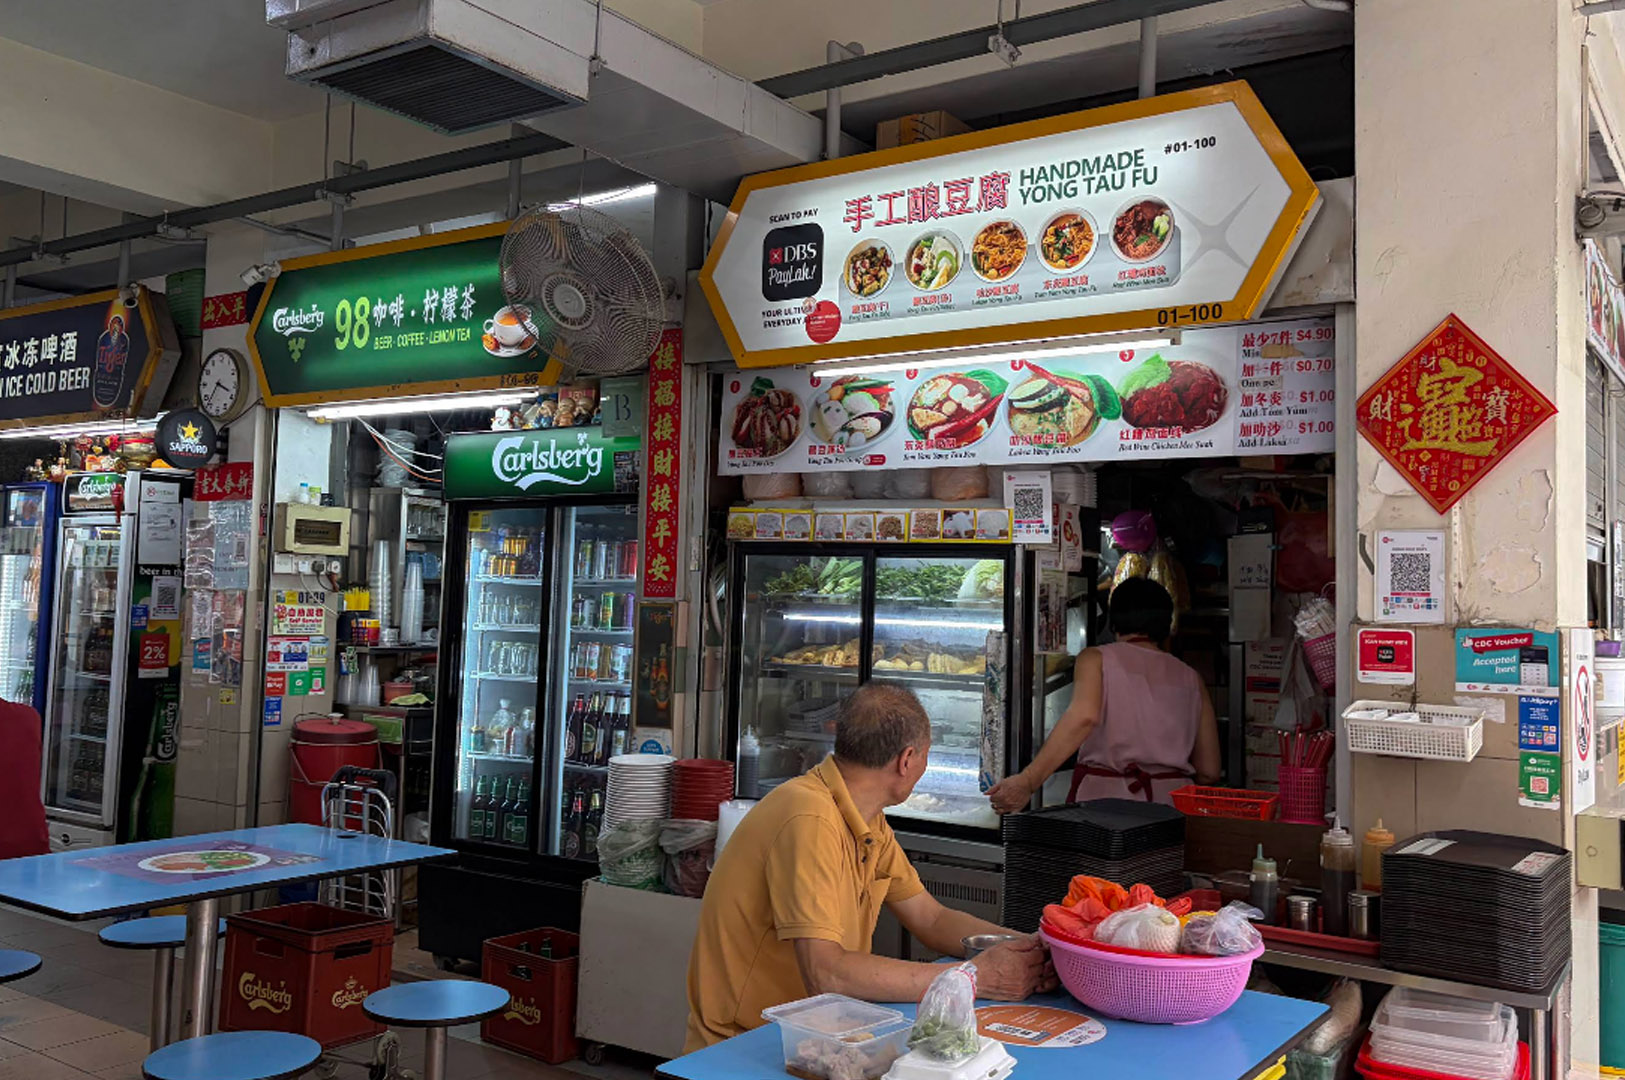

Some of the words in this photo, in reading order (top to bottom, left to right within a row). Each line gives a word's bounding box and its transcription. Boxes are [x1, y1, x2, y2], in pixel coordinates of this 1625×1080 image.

[1163, 136, 1216, 155] #01-100
[1019, 149, 1146, 186] HANDMADE
[1018, 182, 1079, 205] YONG
[1084, 174, 1126, 195] TAU
[1131, 166, 1159, 188] FU
[843, 171, 1011, 233] 手工酿豆腐
[769, 213, 790, 224] SCAN
[791, 211, 802, 220] TO
[803, 208, 819, 218] PAY
[784, 242, 817, 263] DBS
[768, 263, 817, 288] PayLah!
[273, 304, 325, 336] Carlsberg
[335, 296, 370, 350] 98
[762, 308, 782, 318] YOUR
[763, 316, 801, 328] EVERYDAY
[1157, 303, 1223, 325] 01-100
[373, 336, 393, 349] BEER
[397, 333, 424, 347] COFFEE
[429, 330, 455, 345] LEMON
[456, 328, 471, 342] TEA
[5, 375, 23, 398] ICE
[25, 371, 56, 395] COLD
[59, 366, 91, 391] BEER
[1300, 390, 1335, 403] $1.00
[1369, 390, 1394, 422] 財
[1239, 408, 1258, 418] Add
[1286, 406, 1307, 415] Yum
[1239, 421, 1281, 437] 加叻沙
[1298, 421, 1334, 434] $1.00
[169, 441, 208, 455] SAPPORO
[1238, 439, 1256, 447] Add
[492, 433, 603, 490] Carlsberg
[139, 566, 160, 576] beer
[162, 567, 171, 576] in
[143, 645, 166, 660] 2%
[1473, 639, 1493, 648] CDC
[1495, 636, 1529, 646] Voucher
[1473, 655, 1516, 667] Accepted
[1495, 665, 1516, 674] here
[157, 702, 177, 759] Carlsberg
[239, 972, 292, 1014] Carlsberg
[510, 994, 541, 1024] lsberg
